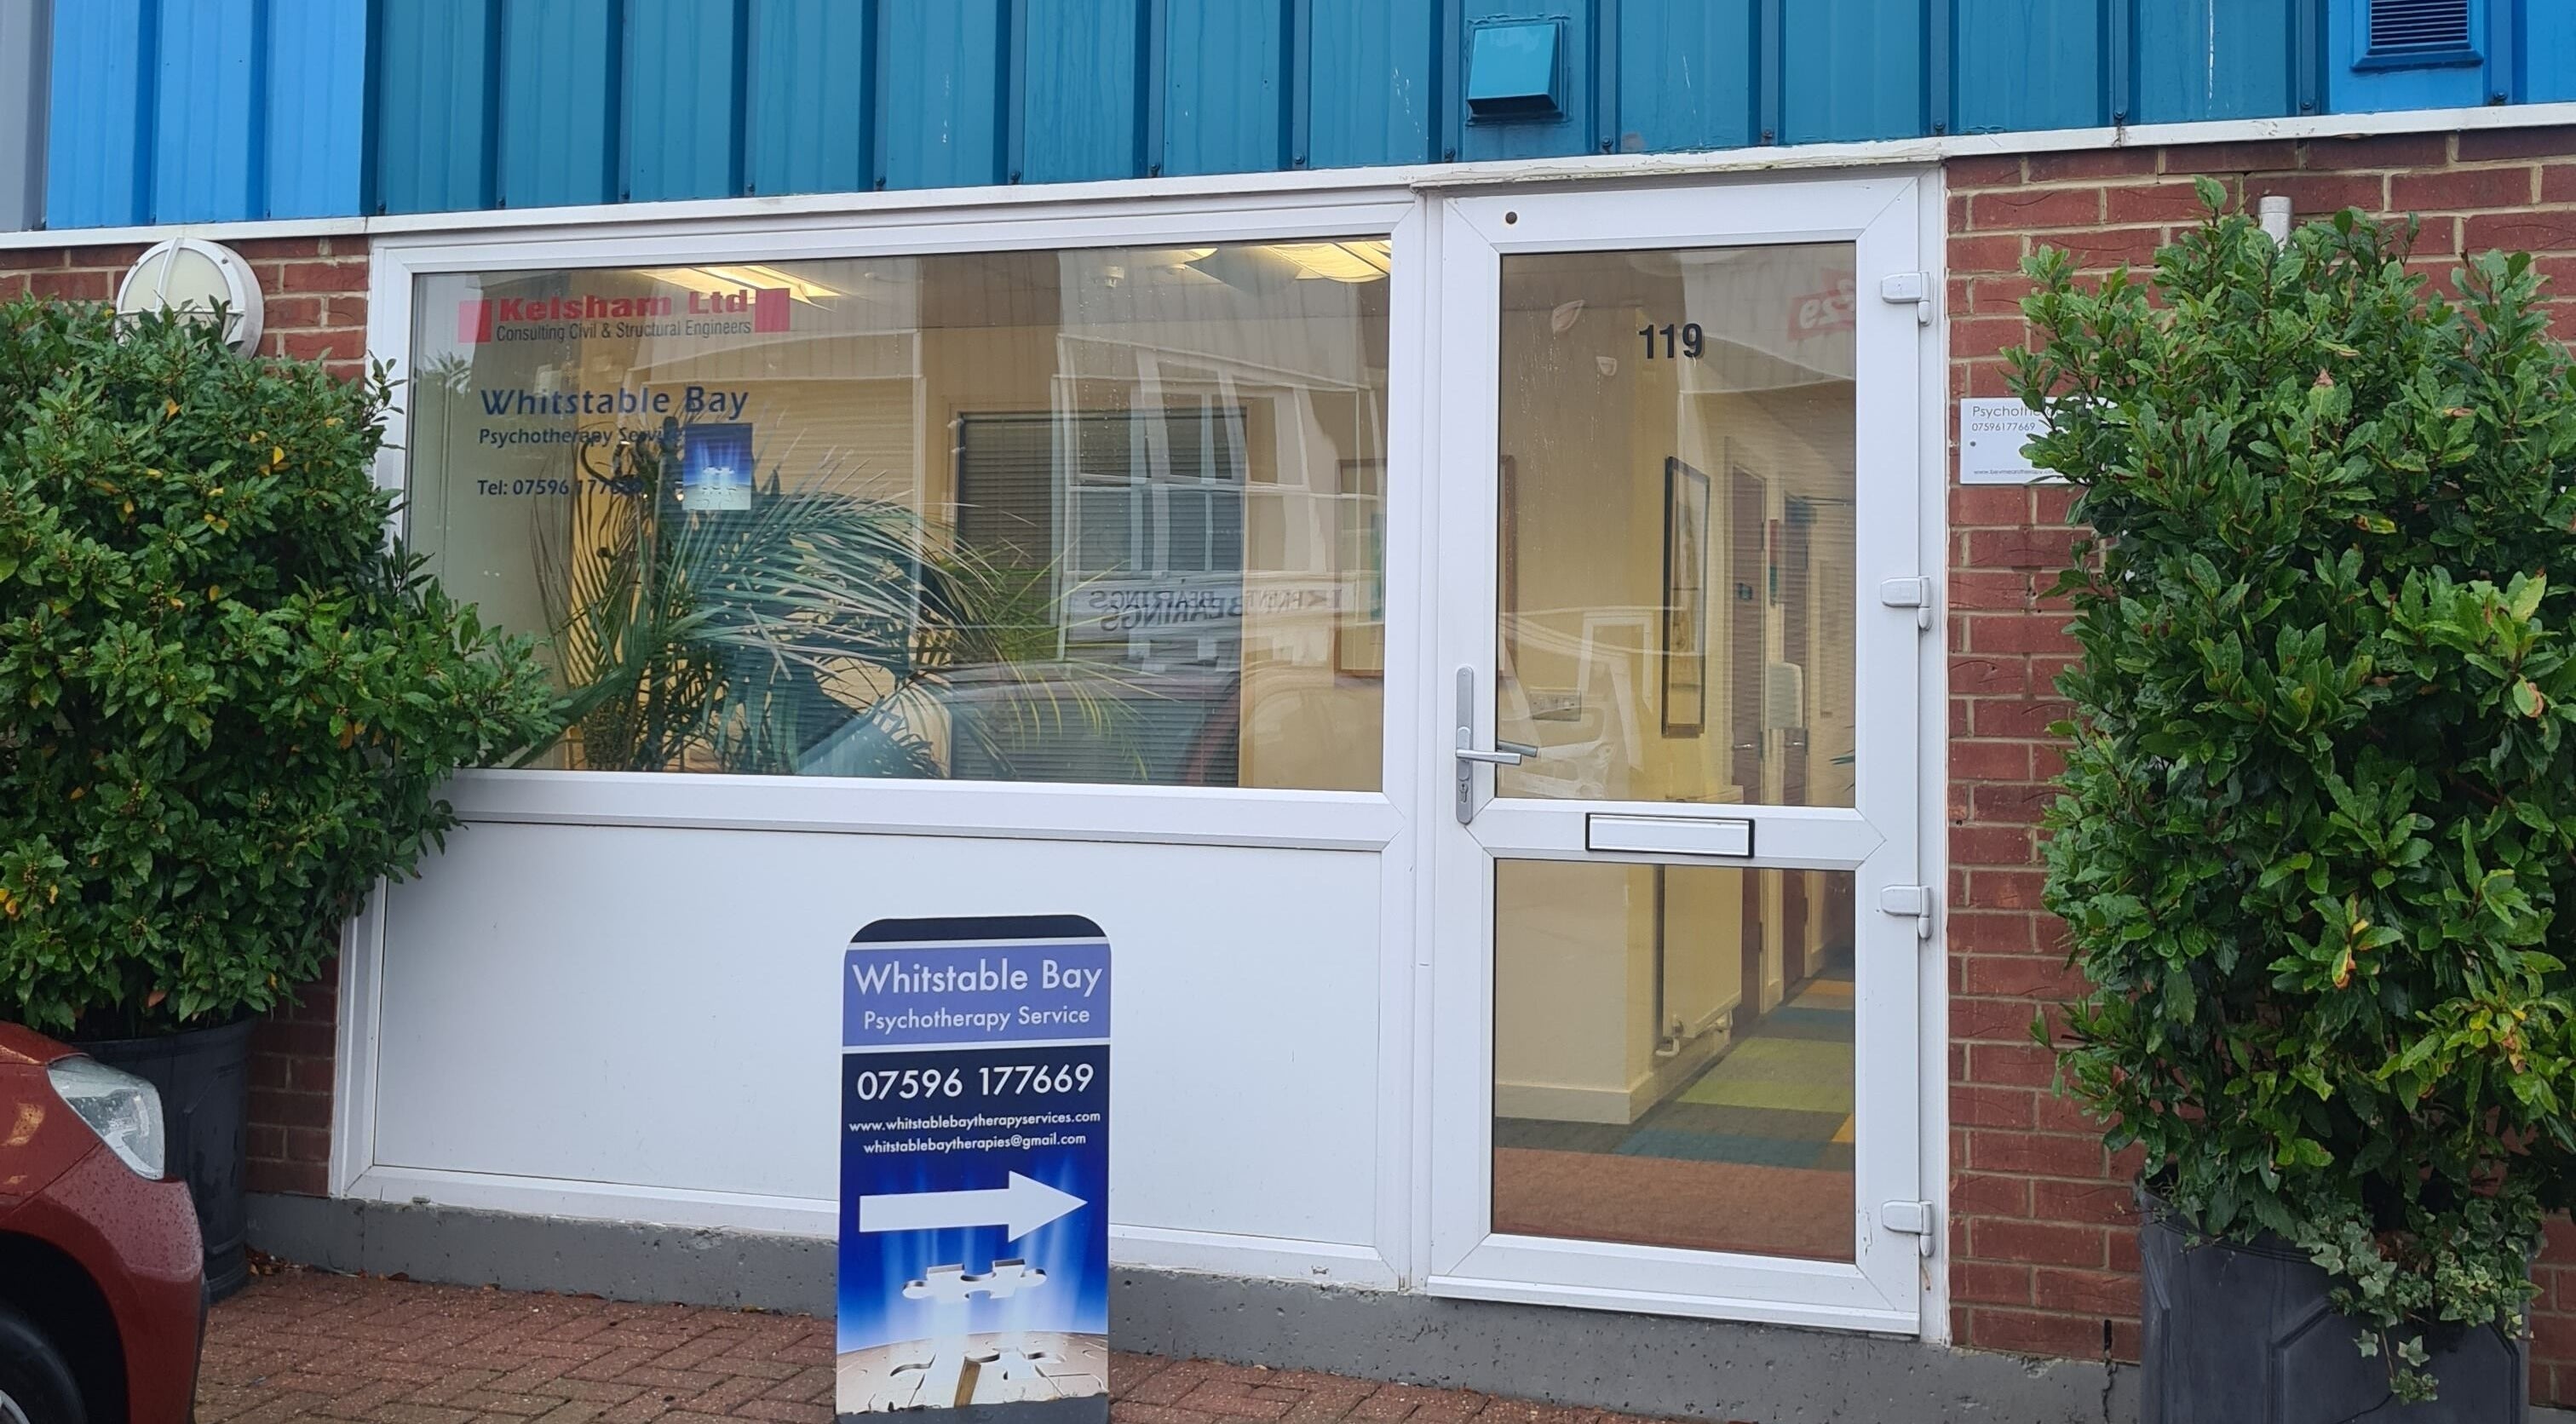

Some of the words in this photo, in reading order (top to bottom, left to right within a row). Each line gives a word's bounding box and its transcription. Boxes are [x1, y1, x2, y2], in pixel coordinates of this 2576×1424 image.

[498, 294, 672, 322] Kelsham
[689, 289, 749, 315] Ltd
[497, 324, 566, 343] Consulting
[570, 322, 598, 339] Civil
[601, 322, 613, 338] &
[616, 319, 682, 338] Structural
[685, 319, 751, 338] Engineers
[1638, 323, 1704, 360] 119
[481, 388, 671, 416] Whitstable
[686, 386, 750, 420] Bay
[479, 428, 613, 449] Psychotherapy
[1971, 422, 2036, 432] 07596177669
[477, 479, 508, 496] Tel:
[513, 479, 570, 496] 07596
[852, 958, 1029, 995] Whitstable
[1042, 959, 1103, 997] Bay
[864, 1008, 1010, 1035] Psychotherapy
[1018, 1006, 1090, 1025] Service
[857, 1068, 963, 1100] 07596
[978, 1064, 1094, 1096] 177669
[848, 1111, 1101, 1133] www.whitstablebaytherapyservices.com
[864, 1134, 1086, 1154] whitstablebaytherapies@gmail.com
